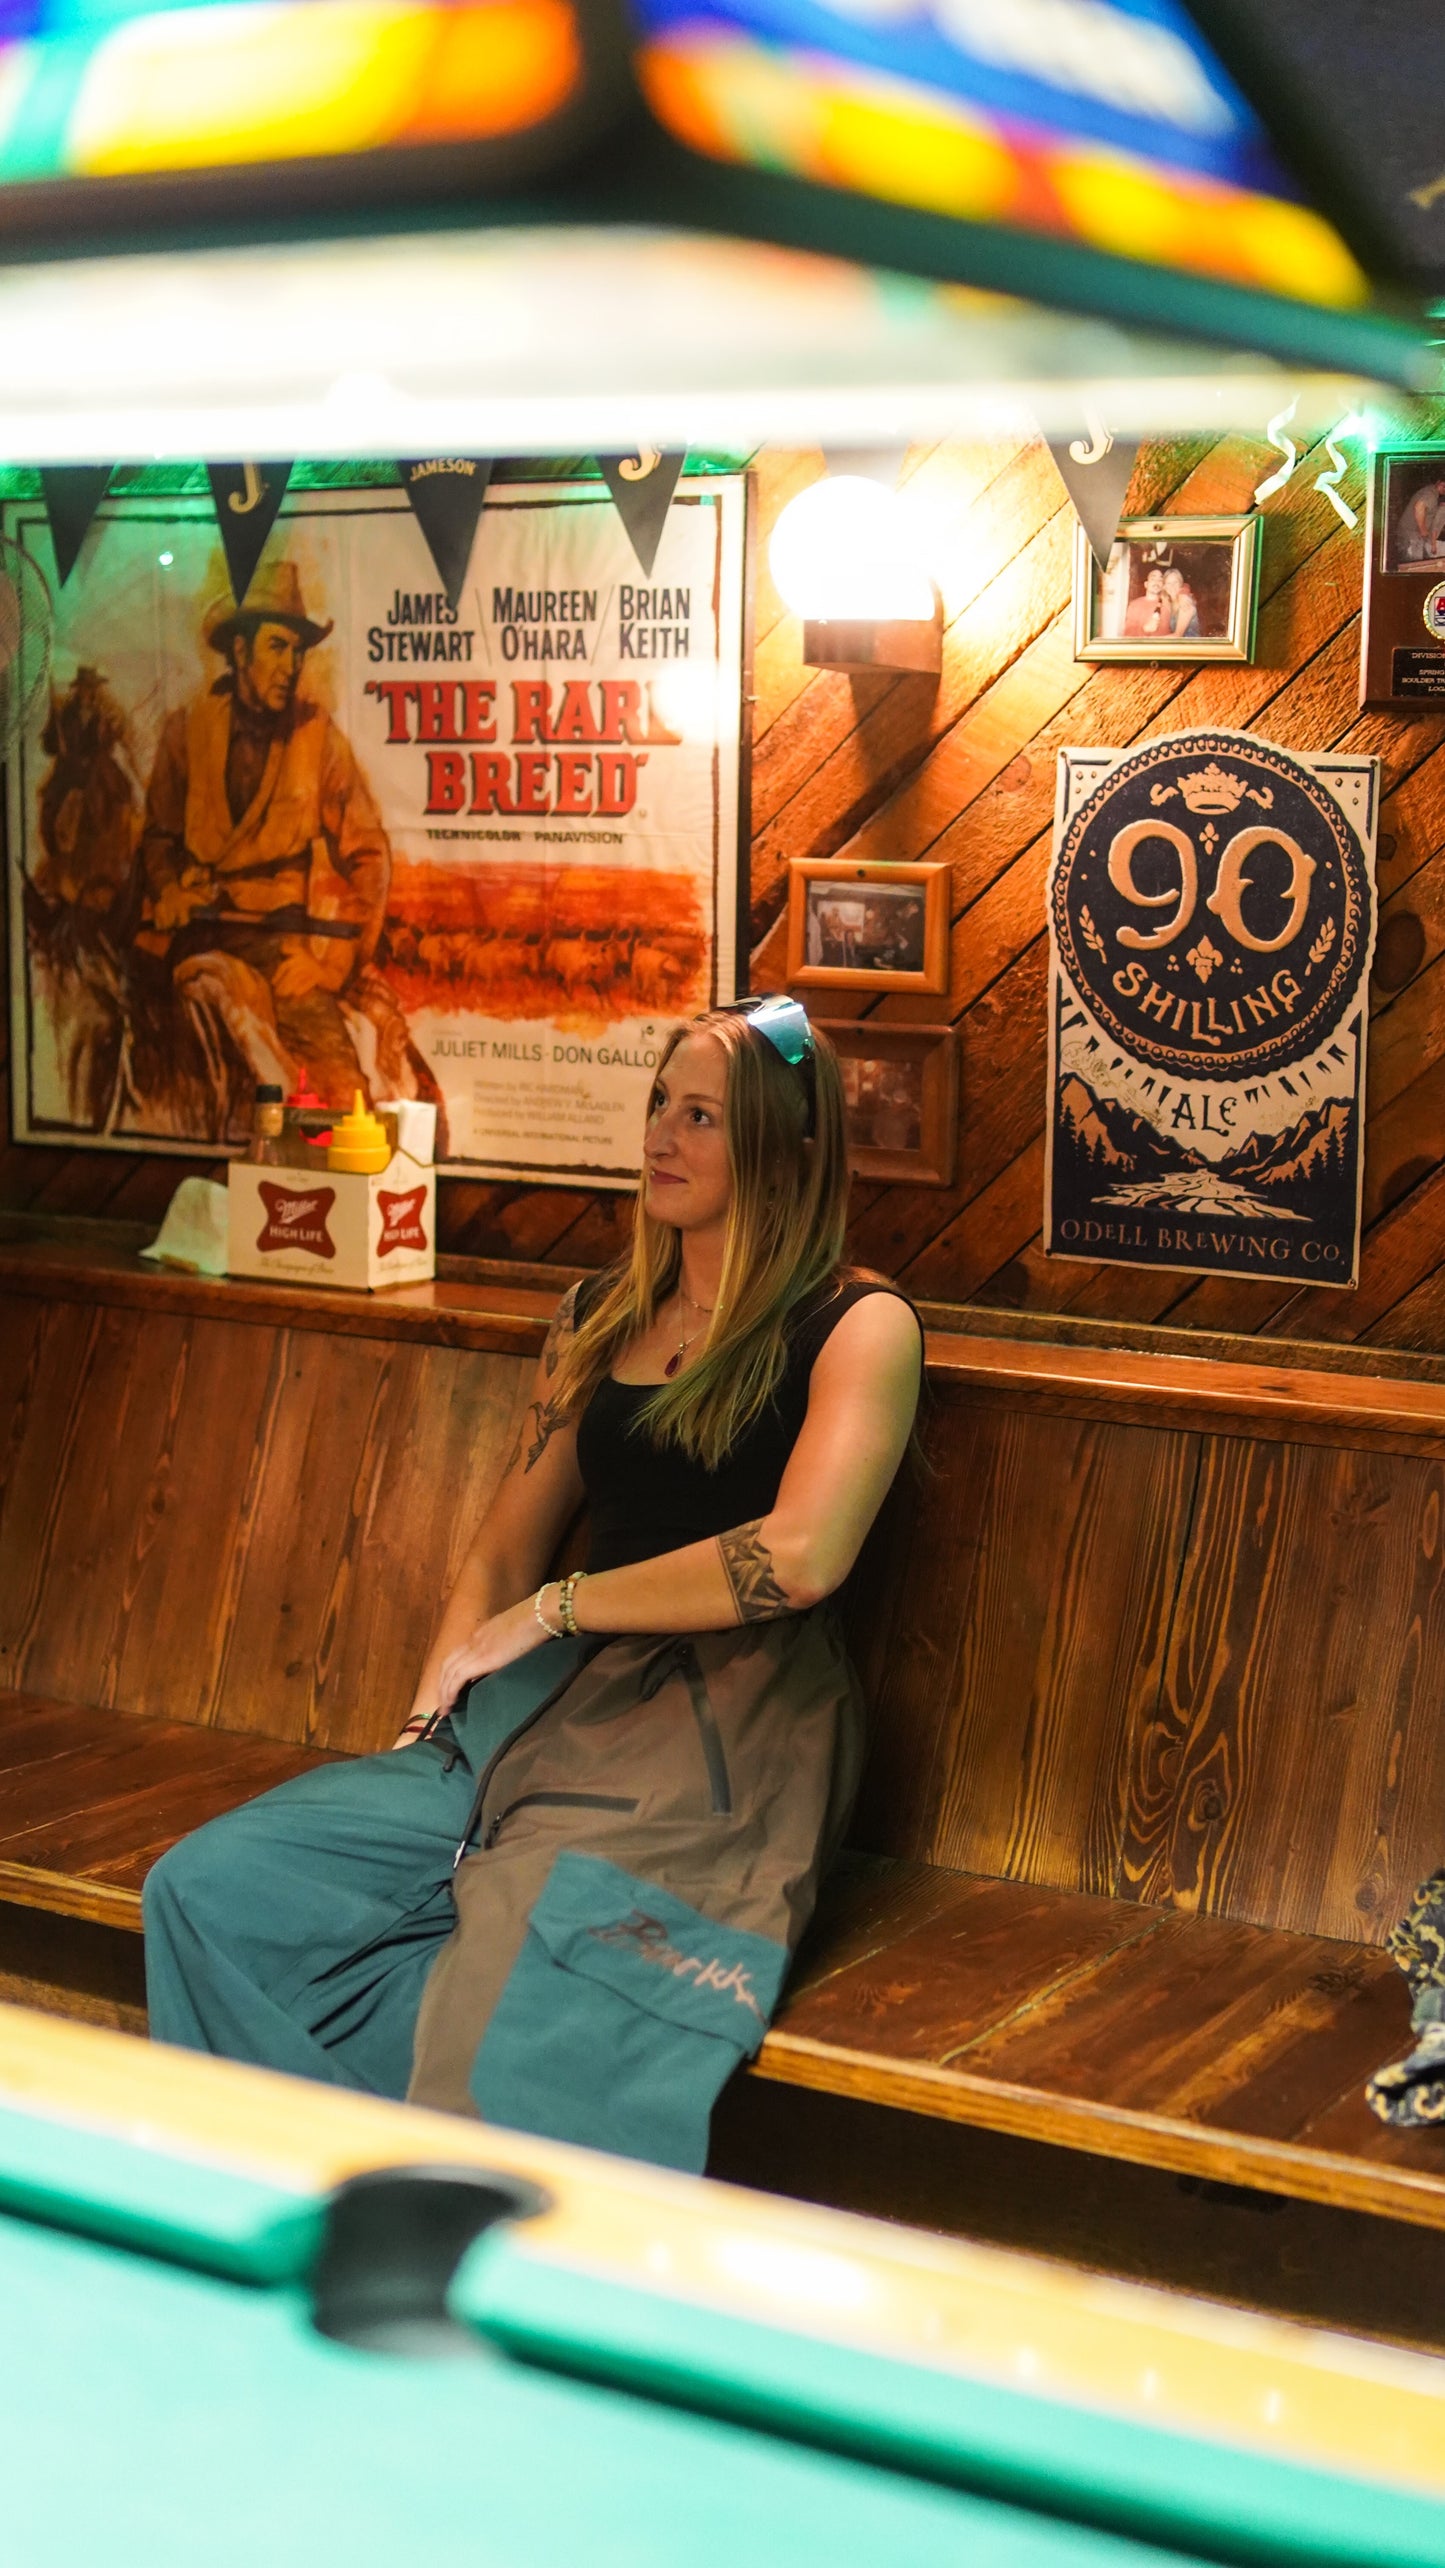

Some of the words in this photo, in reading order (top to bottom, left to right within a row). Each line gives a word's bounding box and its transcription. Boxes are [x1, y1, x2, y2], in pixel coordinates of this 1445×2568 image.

[409, 457, 477, 482] JAMESON
[388, 589, 459, 626] JAMES
[492, 586, 598, 624] MAUREEN
[619, 584, 691, 622] BRIAN
[367, 626, 475, 663] STEWART
[501, 624, 588, 662] O'HARA
[619, 621, 690, 661] KEITH
[426, 828, 521, 842] TECHNICOLOR
[533, 830, 624, 845] PANAVISION
[1107, 818, 1318, 953] 90
[1112, 961, 1303, 1047] SHILLING
[430, 1039, 488, 1058] JULIET
[492, 1041, 543, 1062] MILLS
[552, 1045, 592, 1064] DON
[1170, 1092, 1238, 1137] ALE
[269, 1225, 299, 1241] HIGH
[300, 1229, 324, 1243] LIFE
[1060, 1219, 1149, 1248] ODELL
[1157, 1227, 1291, 1260] BREWING
